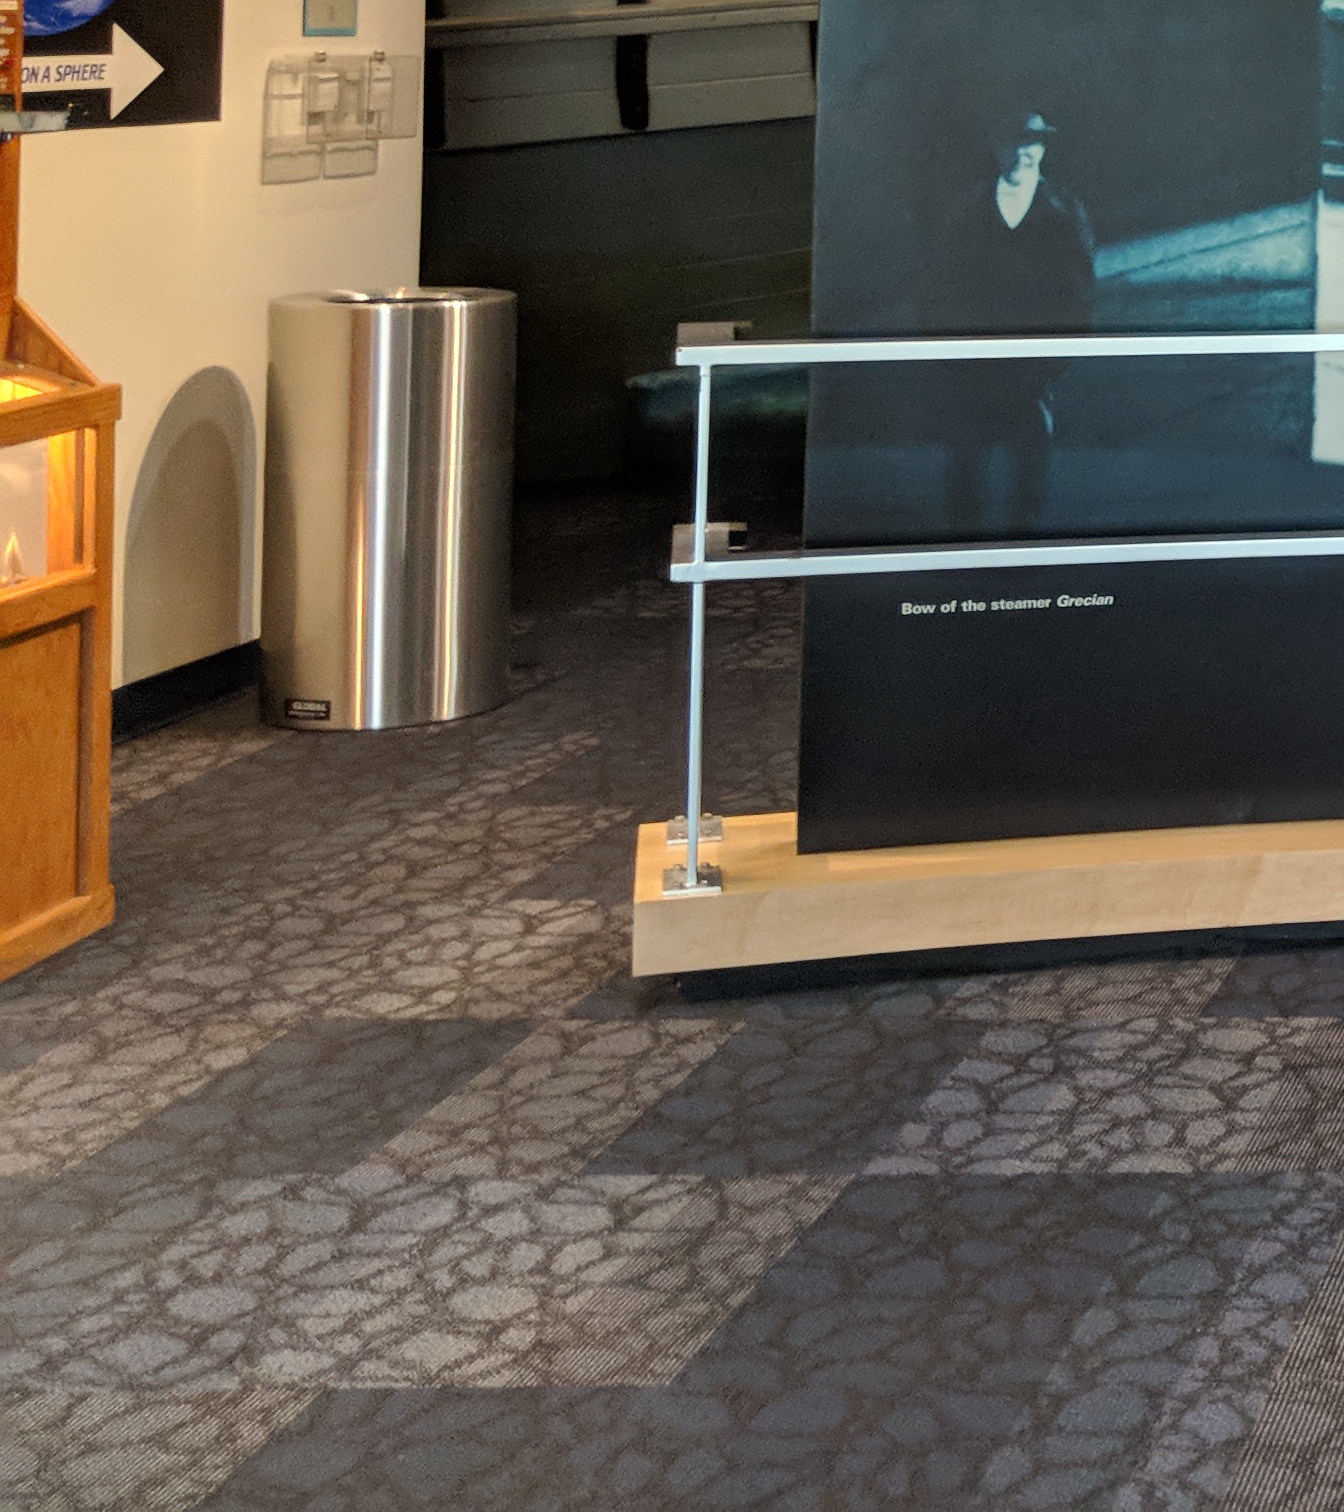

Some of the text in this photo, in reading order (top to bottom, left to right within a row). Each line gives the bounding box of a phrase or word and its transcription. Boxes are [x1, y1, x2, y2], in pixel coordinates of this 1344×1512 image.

[41, 65, 51, 83] A
[55, 63, 107, 83] SPHERE
[900, 593, 1115, 616] Bow of the steamer Grecian
